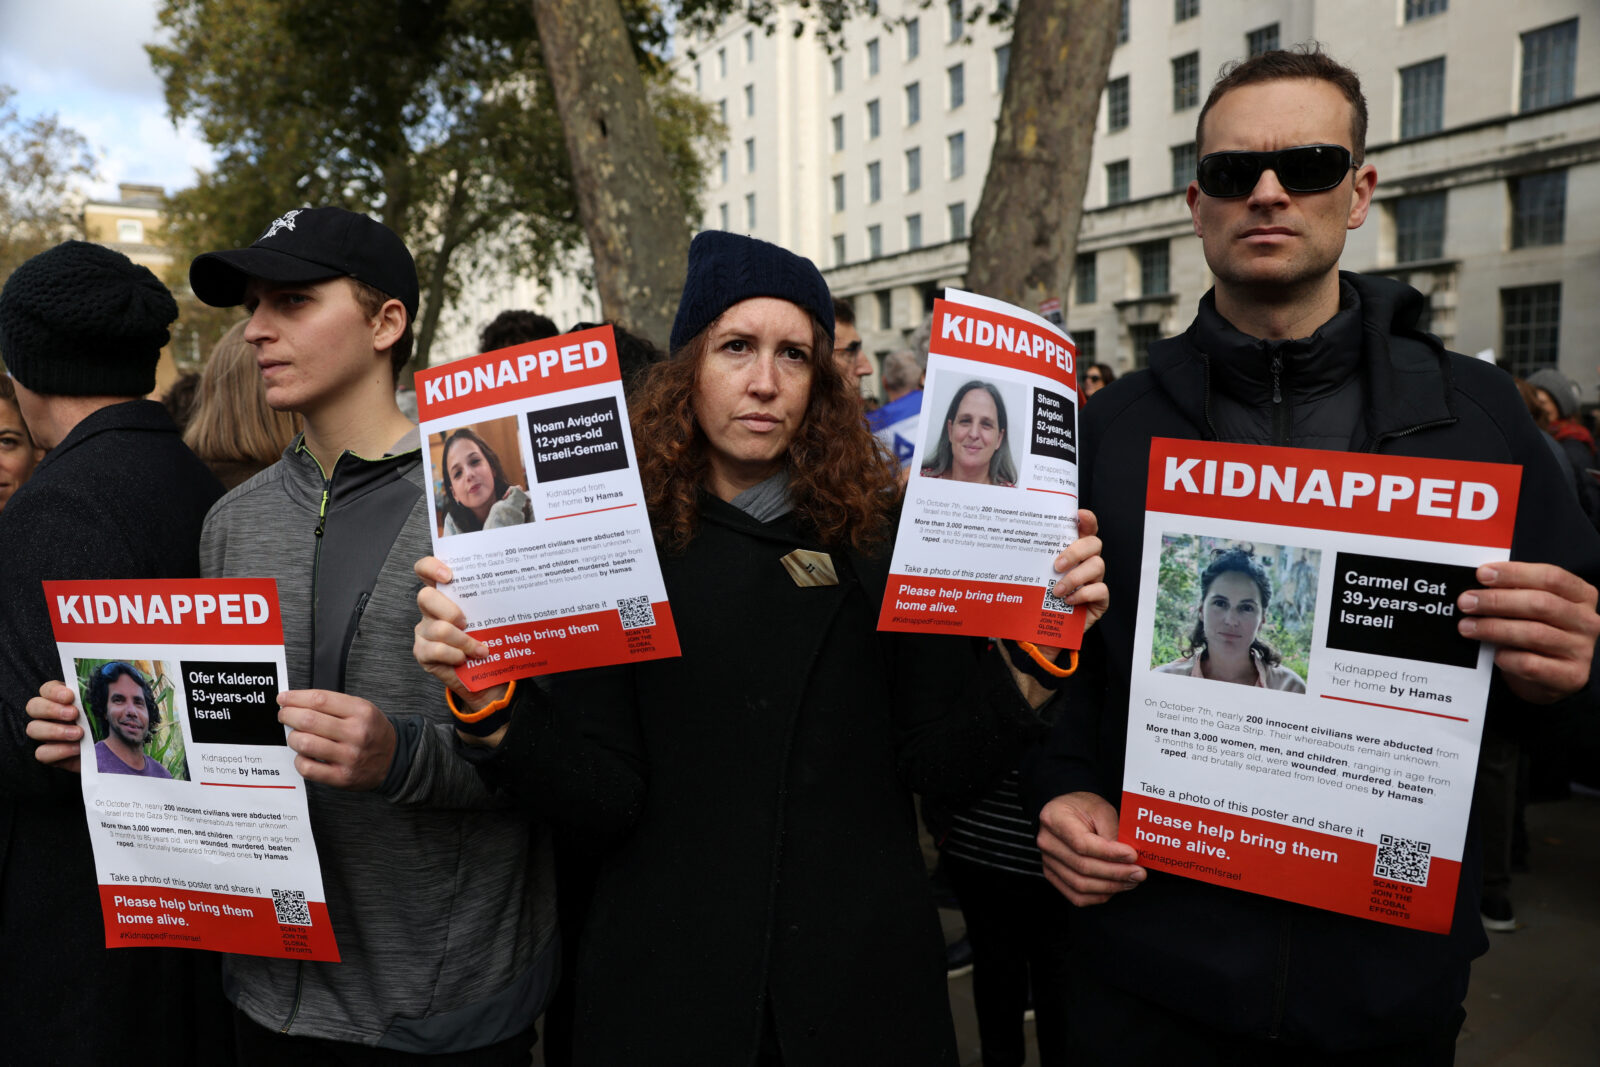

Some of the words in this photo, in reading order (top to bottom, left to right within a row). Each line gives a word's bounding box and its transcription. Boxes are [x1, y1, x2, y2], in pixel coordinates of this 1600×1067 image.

[942, 312, 1073, 374] KIDNAPPED
[424, 340, 608, 405] KIDNAPPED
[1038, 394, 1060, 408] Sharon
[533, 421, 564, 434] Noam
[567, 410, 613, 428] Avigdori
[1037, 408, 1063, 422] Avigdori
[536, 427, 603, 448] 12-years-old
[538, 442, 618, 462] Israeli-German
[585, 496, 594, 505] by
[597, 491, 623, 500] Hamas
[1163, 457, 1499, 520] KIDNAPPED
[905, 565, 921, 573] Take
[930, 568, 951, 576] photo
[1345, 571, 1408, 591] Carmel
[1414, 579, 1447, 595] Gat
[899, 584, 936, 596] Please
[939, 588, 962, 600] help
[965, 590, 993, 603] bring
[996, 593, 1023, 603] them
[1342, 591, 1454, 616] 39-years-old
[57, 594, 270, 624] KIDNAPPED
[485, 618, 506, 627] photo
[534, 609, 558, 619] poster
[561, 606, 575, 614] and
[578, 603, 599, 611] share
[896, 600, 926, 611] home
[930, 602, 958, 612] alive.
[1340, 610, 1394, 628] Israeli
[505, 632, 531, 644] help
[534, 628, 566, 640] bring
[568, 624, 599, 634] them
[504, 647, 535, 659] alive.
[189, 672, 214, 684] Ofer
[218, 672, 274, 685] Kalderon
[1334, 662, 1398, 680] Kidnapped
[1402, 672, 1428, 684] from
[192, 690, 265, 704] 53-years-old
[1332, 676, 1350, 686] her
[1354, 680, 1386, 692] home
[1390, 685, 1404, 696] by
[1409, 688, 1452, 703] Hamas
[194, 707, 231, 719] Israeli
[1144, 699, 1157, 707] On
[1160, 701, 1194, 713] October
[1217, 711, 1243, 722] nearly
[1246, 715, 1263, 724] 200
[1266, 718, 1308, 732] innocent
[1311, 726, 1352, 739] civilians
[1356, 736, 1381, 744] were
[1384, 739, 1433, 755] abducted
[1437, 748, 1459, 759] from
[1157, 711, 1180, 721] Israel
[1183, 716, 1198, 724] into
[1217, 721, 1240, 731] Gaza
[1270, 730, 1292, 740] Their
[1295, 735, 1355, 751] whereabouts
[1358, 747, 1390, 758] remain
[201, 754, 242, 763] Kidnapped
[245, 755, 262, 763] from
[1146, 724, 1168, 734] More
[1171, 729, 1191, 738] than
[1194, 732, 1218, 742] 3,000
[1221, 738, 1256, 751] women,
[1260, 745, 1282, 755] men,
[1286, 750, 1304, 758] and
[1354, 762, 1390, 776] ranging
[1394, 769, 1402, 777] in
[1405, 772, 1425, 782] age
[1429, 775, 1450, 786] from
[1163, 738, 1194, 749] months
[1196, 742, 1204, 750] to
[1207, 745, 1218, 753] 85
[1221, 750, 1244, 758] years
[1267, 758, 1288, 766] were
[239, 767, 248, 776] by
[1192, 754, 1208, 762] and
[1211, 757, 1243, 769] brutally
[1246, 764, 1291, 778] separated
[1294, 770, 1314, 782] from
[1317, 776, 1342, 788] loved
[1346, 784, 1368, 793] ones
[1372, 787, 1385, 798] by
[1140, 782, 1165, 795] Take
[1169, 790, 1175, 798] a
[1179, 792, 1210, 805] photo
[1214, 799, 1225, 807] of
[1228, 801, 1248, 812] this
[1252, 806, 1288, 820] poster
[1292, 816, 1314, 826] and
[1318, 821, 1353, 834] share
[1357, 827, 1364, 837] it
[1136, 827, 1181, 848] home
[1186, 840, 1230, 860] alive.
[1137, 808, 1192, 831] Please
[1198, 821, 1234, 842] help
[1240, 830, 1286, 854] bring
[1292, 841, 1338, 863] them
[1136, 850, 1242, 880] KidnappedFromIsrael
[110, 873, 129, 882] Take
[140, 875, 161, 883] photo
[172, 879, 186, 887] this
[188, 881, 211, 889] poster
[214, 883, 228, 892] and
[231, 885, 254, 893] share
[1373, 880, 1398, 890] SCAN
[1371, 897, 1407, 910] GLOBAL
[1372, 889, 1392, 898] JOIN
[1396, 894, 1412, 902] THE
[114, 895, 156, 907] Please
[159, 897, 185, 912] help
[188, 900, 220, 916] bring
[222, 904, 254, 917] them
[1369, 906, 1410, 919] EFFORTS
[117, 912, 153, 924] home
[157, 914, 189, 926] alive.
